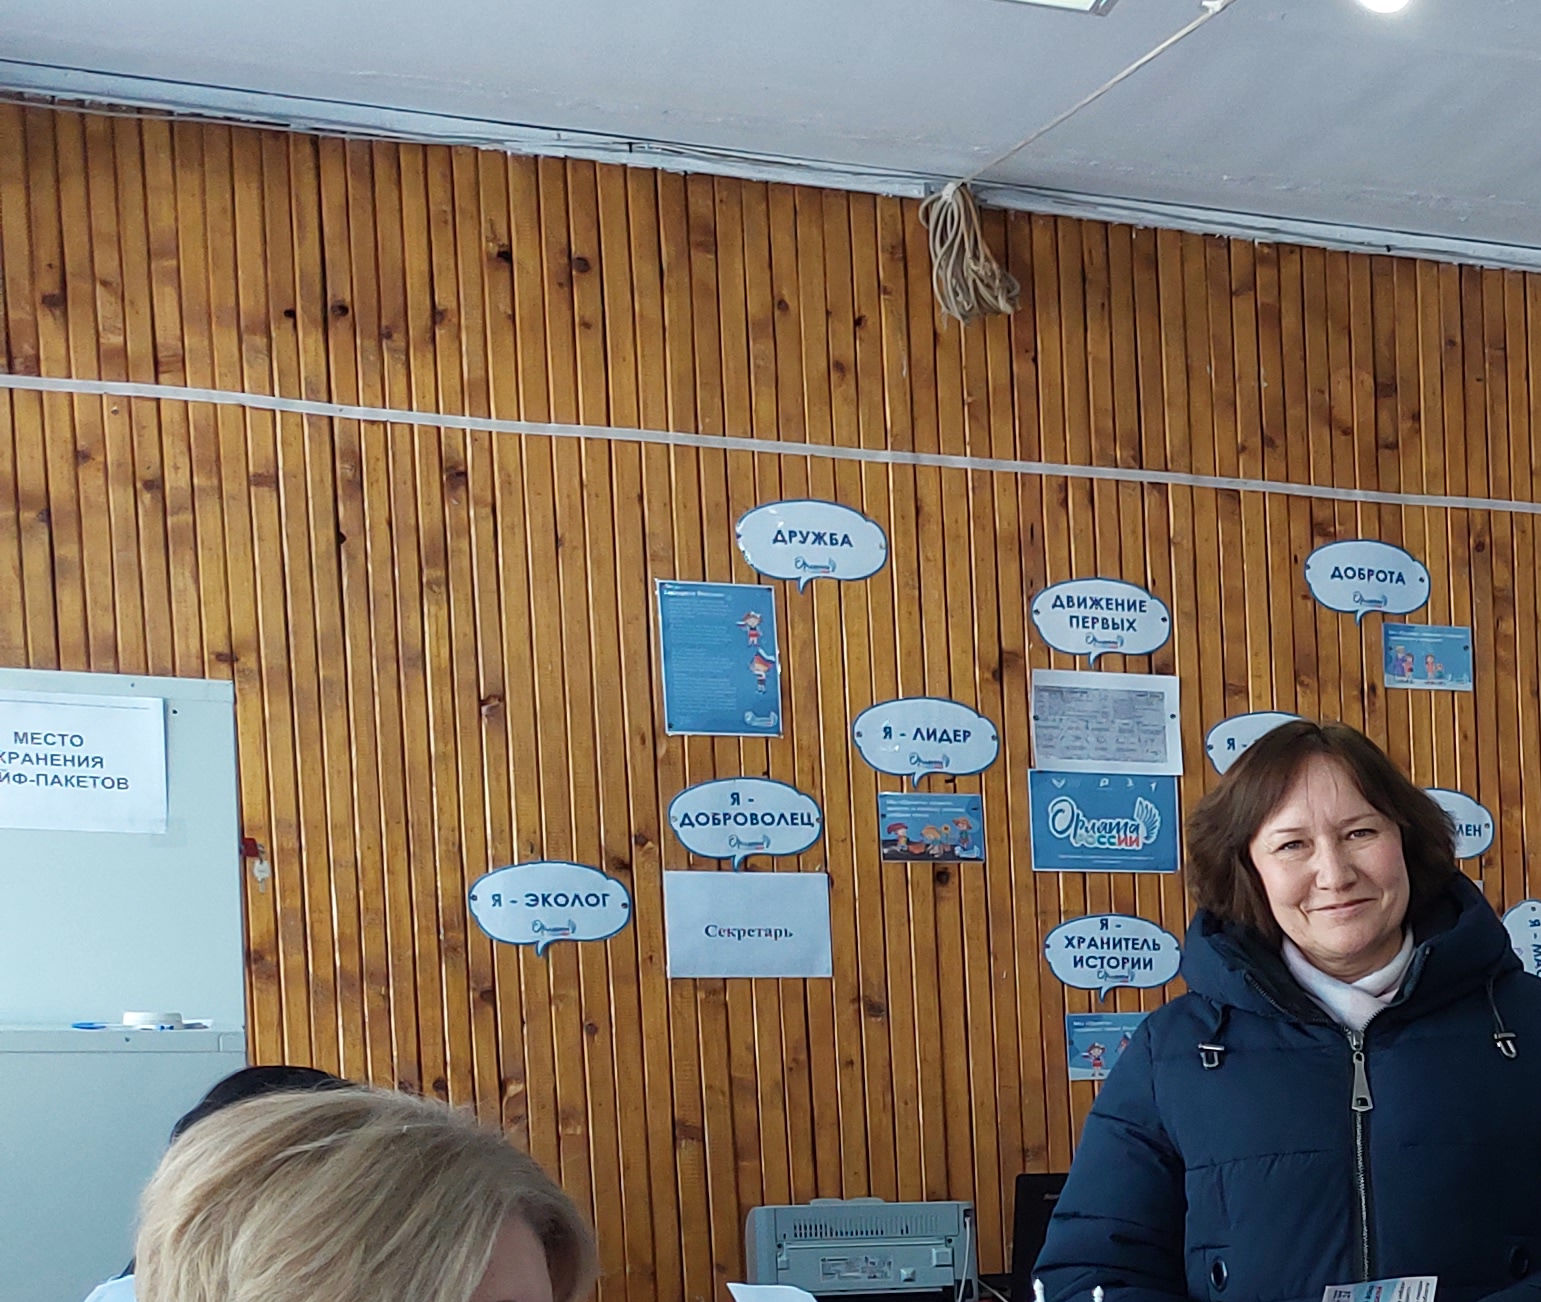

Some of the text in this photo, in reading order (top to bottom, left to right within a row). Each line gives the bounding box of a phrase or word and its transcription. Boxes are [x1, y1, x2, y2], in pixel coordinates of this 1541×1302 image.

[772, 529, 854, 548] ДРУЖБА
[1330, 566, 1406, 586] ДОБРОТА
[1051, 594, 1148, 614] ДВИЖЕНИЕ
[1069, 615, 1137, 632] ПЕРВЫХ
[13, 731, 84, 748] МЕСТО
[882, 726, 893, 740] Я
[912, 727, 972, 744] ЛИДЕР
[1226, 738, 1236, 751] Я
[0, 751, 105, 769] ХРАНЕНИЯ
[730, 792, 741, 806] Я
[679, 812, 815, 828] ДОБРОВОЛЕЦ
[1050, 798, 1140, 836] Орлята
[491, 893, 502, 907] Я
[524, 892, 611, 908] ЭКОЛОГ
[704, 924, 794, 941] Секретарь
[1099, 918, 1109, 930] Я
[1064, 935, 1161, 951] ХРАНИТЕЛЬ
[1073, 955, 1153, 971] ИСТОРИИ
